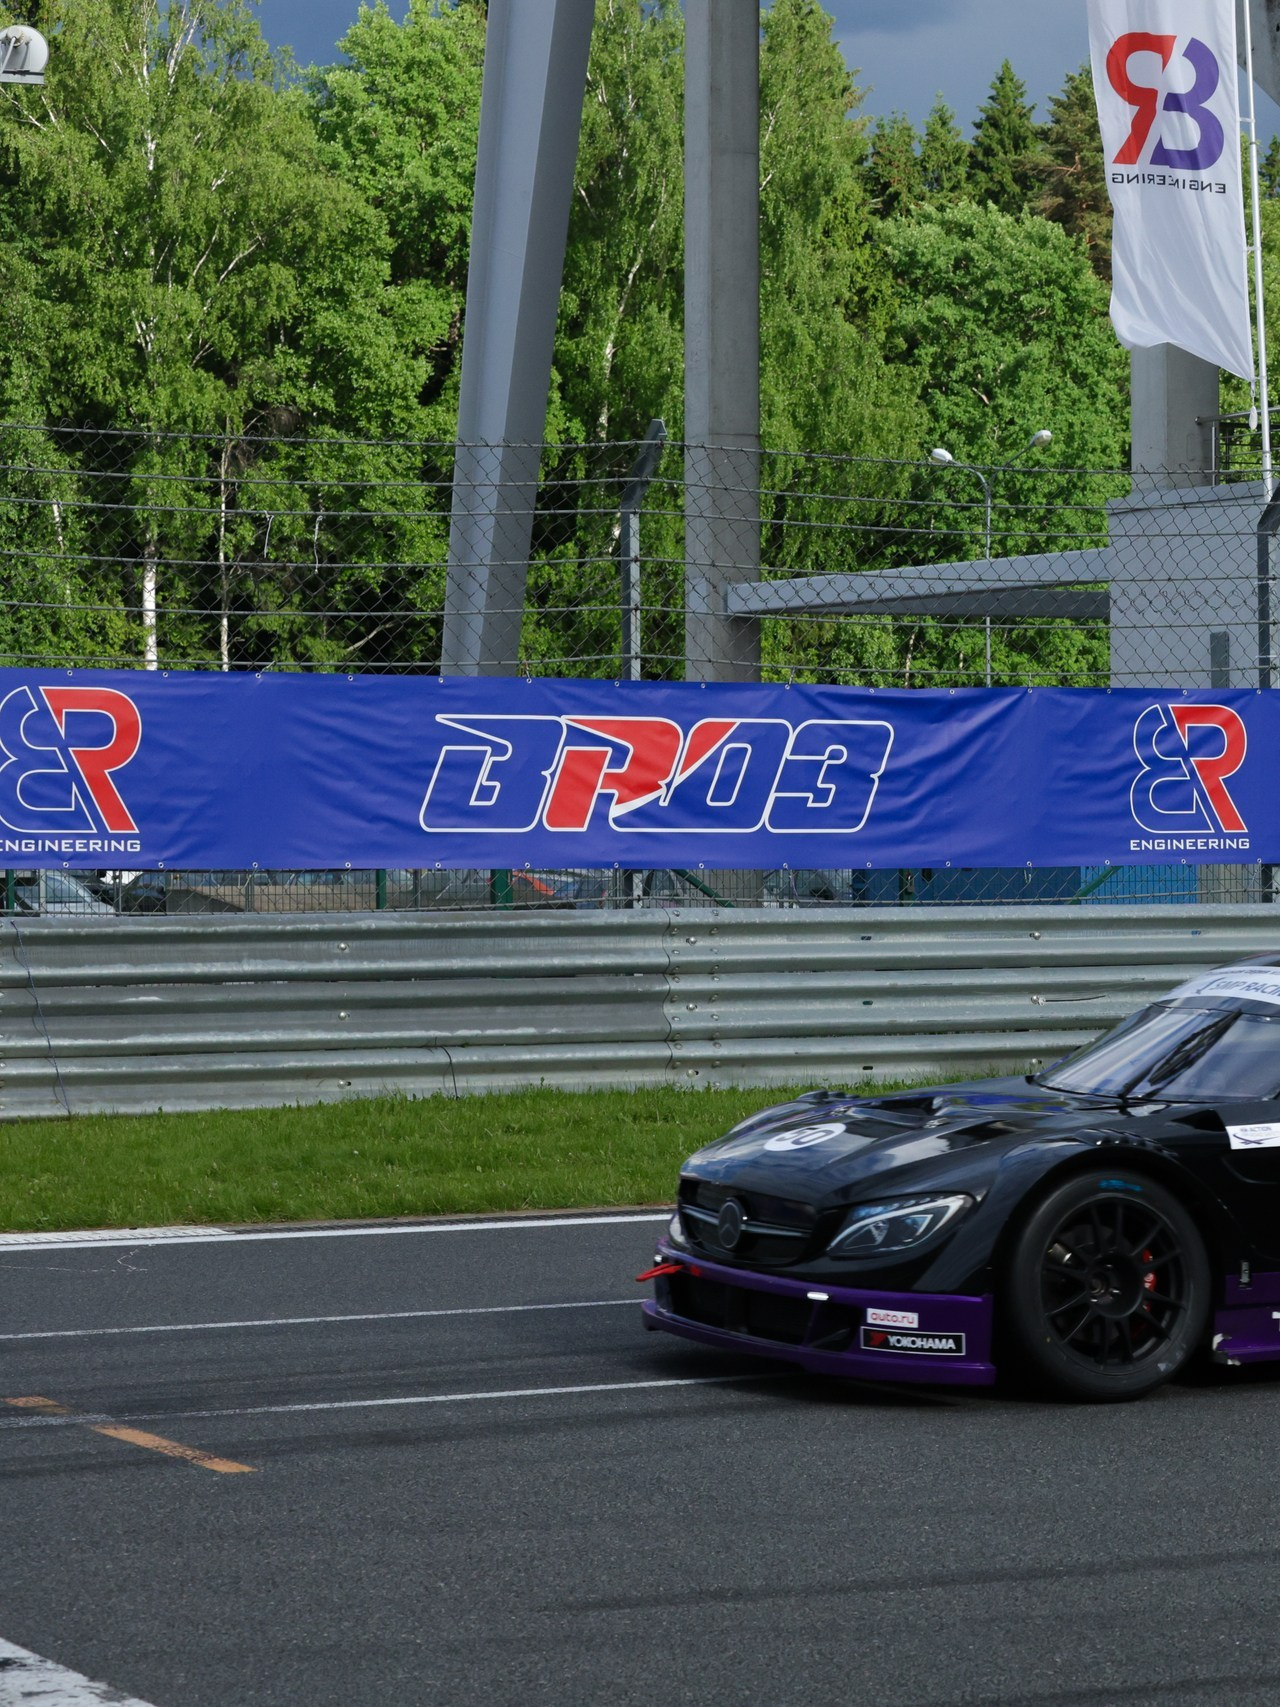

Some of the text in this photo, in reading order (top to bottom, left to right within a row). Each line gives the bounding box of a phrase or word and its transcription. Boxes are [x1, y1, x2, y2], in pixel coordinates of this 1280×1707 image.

[0, 839, 141, 852] NGINEERING
[1129, 838, 1250, 851] ENGINEERING
[870, 1312, 915, 1325] auto.ru
[887, 1335, 957, 1350] YOKOHAMA
